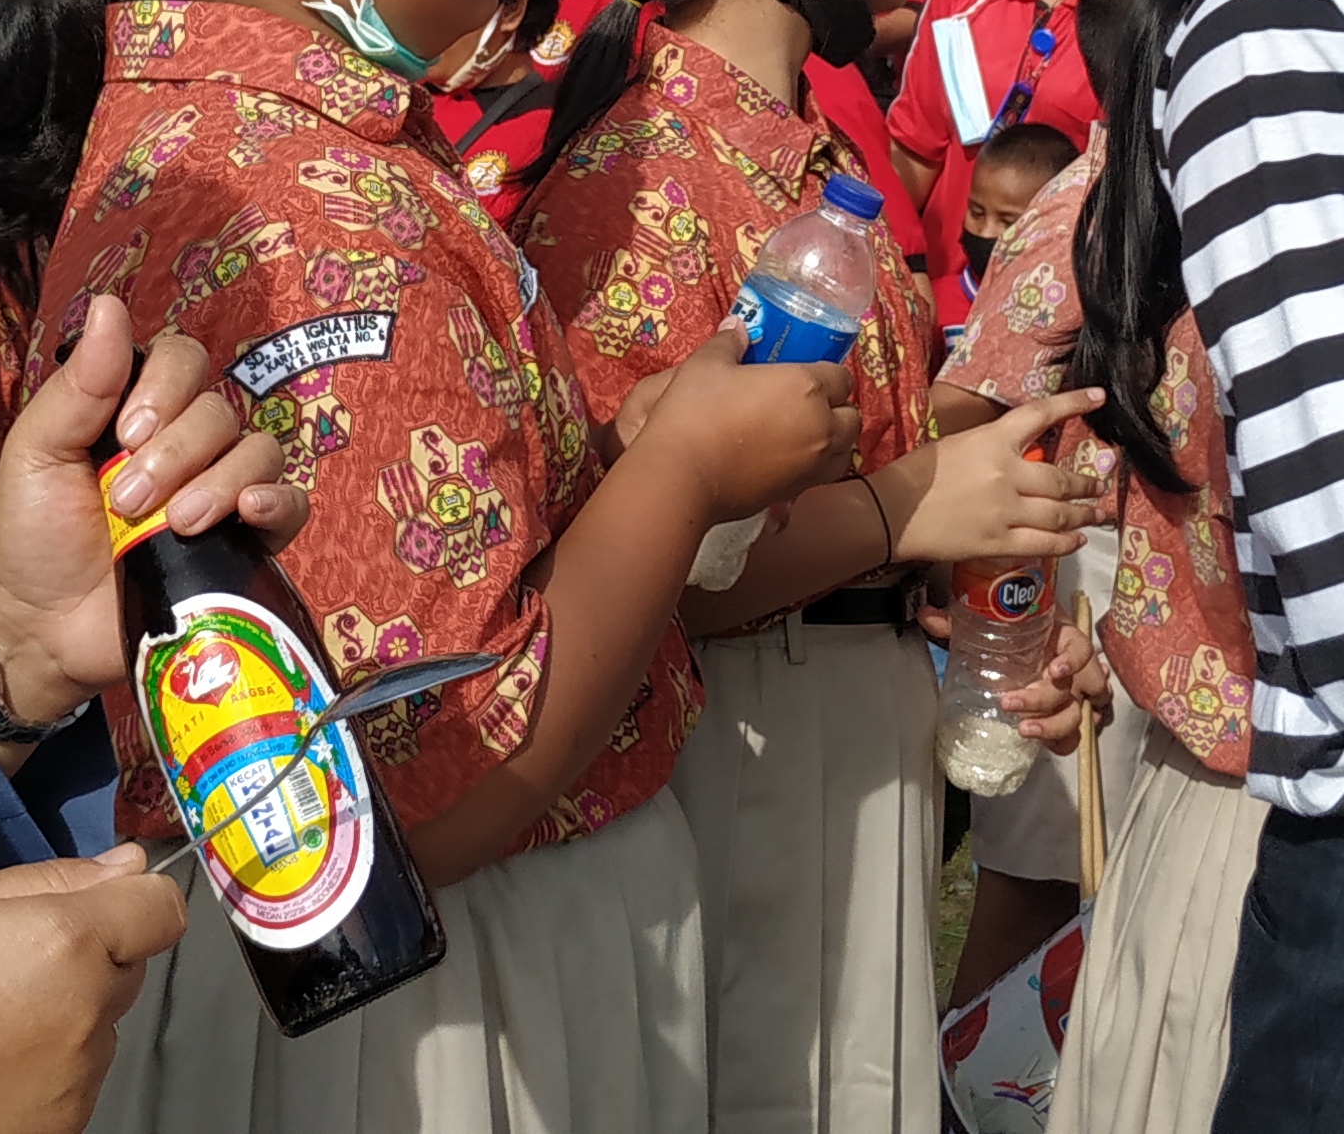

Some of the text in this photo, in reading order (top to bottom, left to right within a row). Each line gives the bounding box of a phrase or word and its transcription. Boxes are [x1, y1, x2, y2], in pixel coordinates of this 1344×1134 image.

[244, 315, 378, 371] SD. ST. IGNATIUS
[264, 346, 304, 374] KARYA
[306, 332, 350, 353] WISATA
[355, 331, 375, 343] NO.
[1002, 583, 1035, 606] Cleo
[230, 685, 276, 704] ANGSA
[229, 763, 267, 787] KECAP
[241, 776, 290, 856] KNTAL
